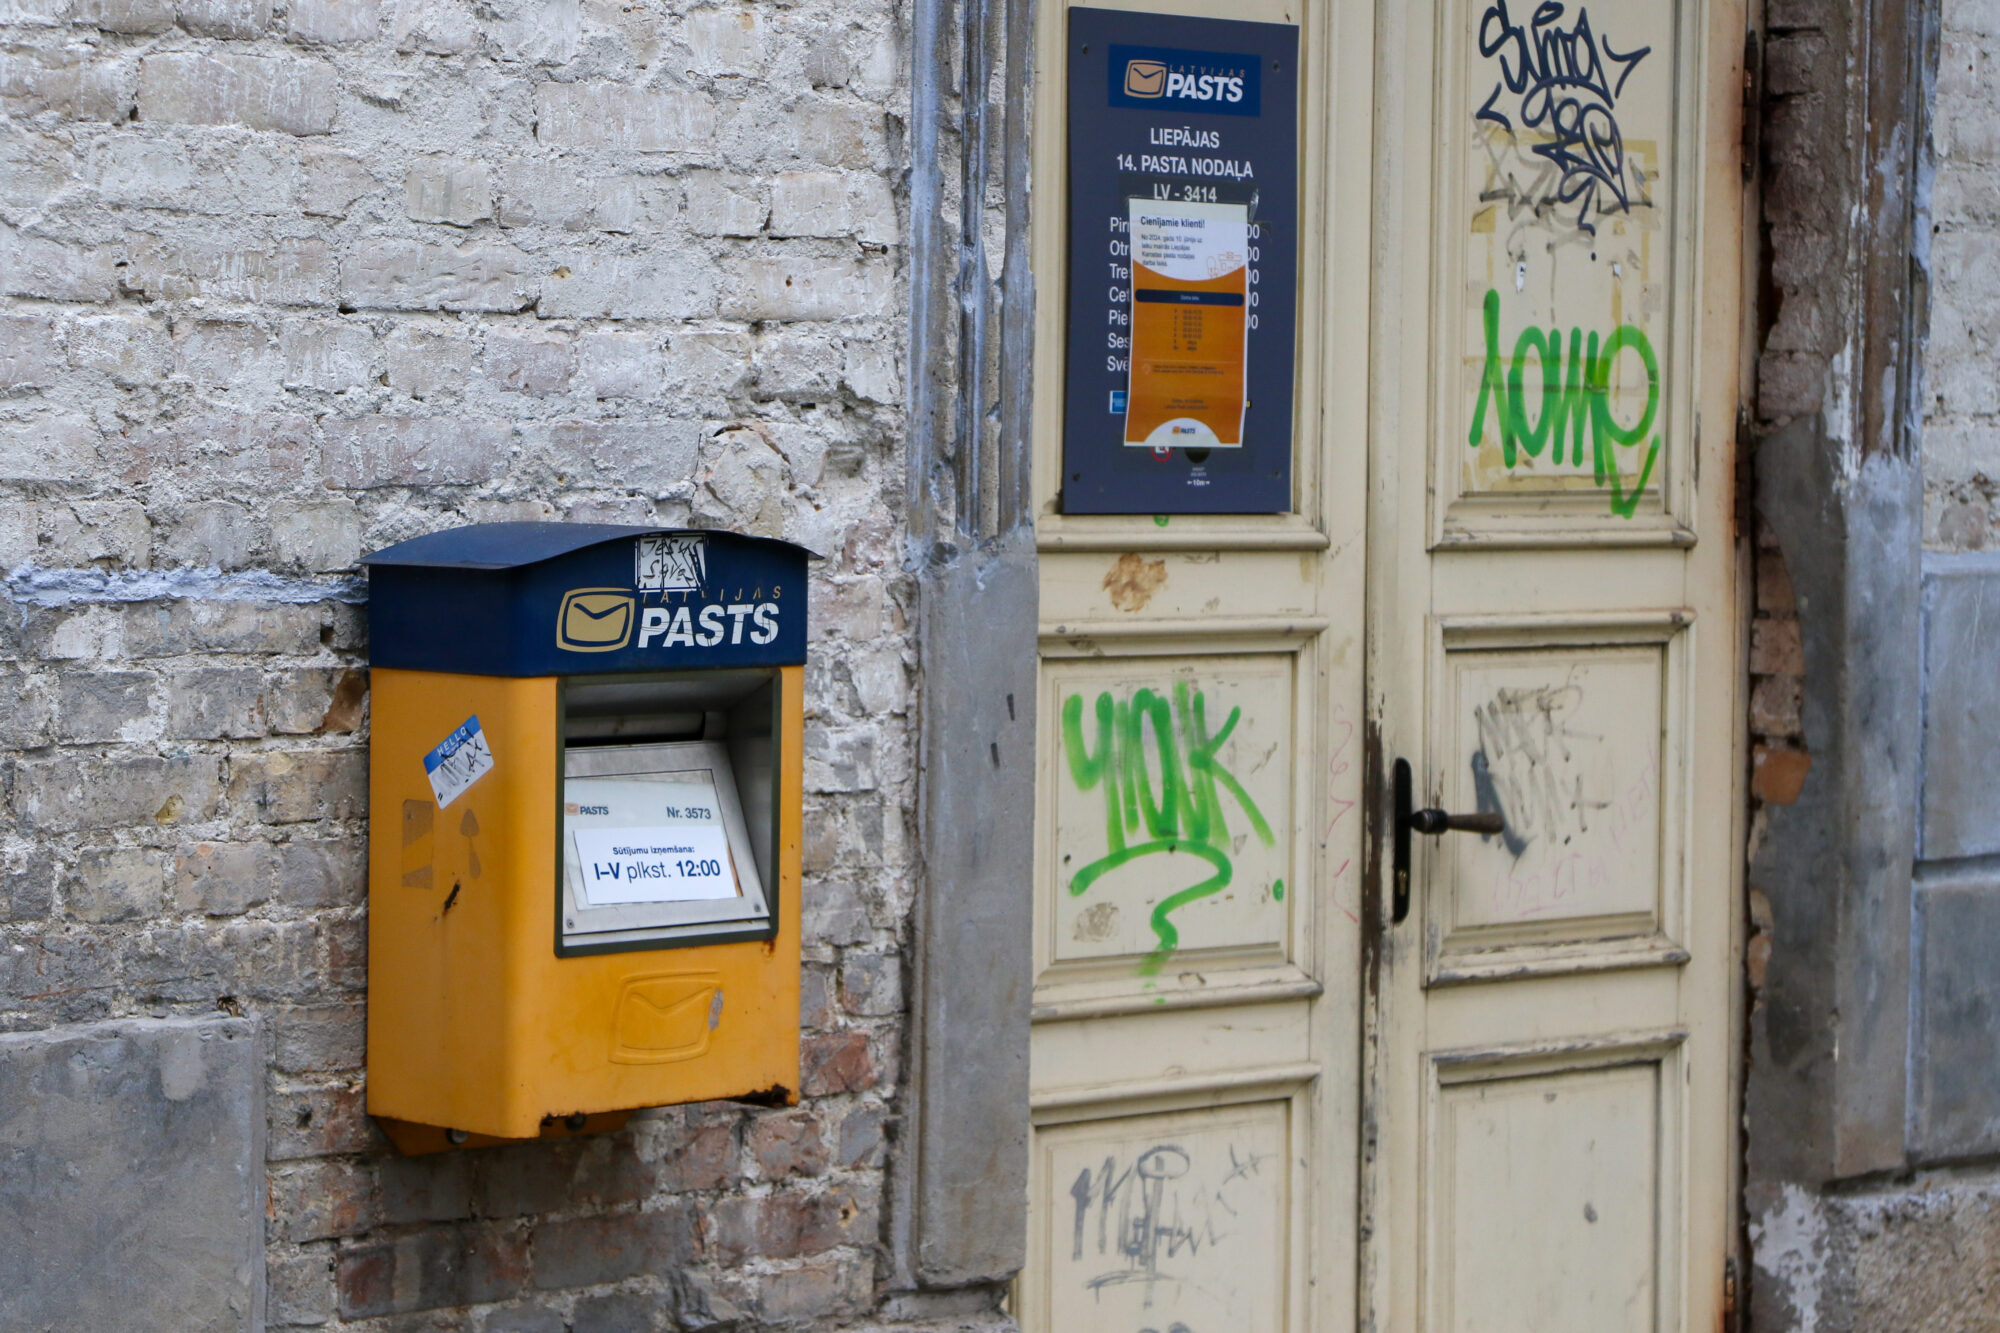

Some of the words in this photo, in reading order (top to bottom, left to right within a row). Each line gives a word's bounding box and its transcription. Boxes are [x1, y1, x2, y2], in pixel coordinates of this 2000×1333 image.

[1169, 64, 1245, 78] LATVIJAS
[1166, 72, 1243, 102] PASTS
[1150, 126, 1220, 148] LIEPĀJAS
[1116, 153, 1137, 171] 14.
[1141, 154, 1188, 174] PASTA
[1192, 158, 1254, 181] NODAĻA
[1153, 183, 1171, 200] LV
[1184, 185, 1217, 202] 3414
[637, 602, 779, 648] PASTS
[579, 806, 609, 816] PASTS
[666, 806, 682, 818] Nr.
[685, 807, 711, 819] 3573
[626, 861, 671, 883] plkst.
[676, 859, 721, 877] 12:00
